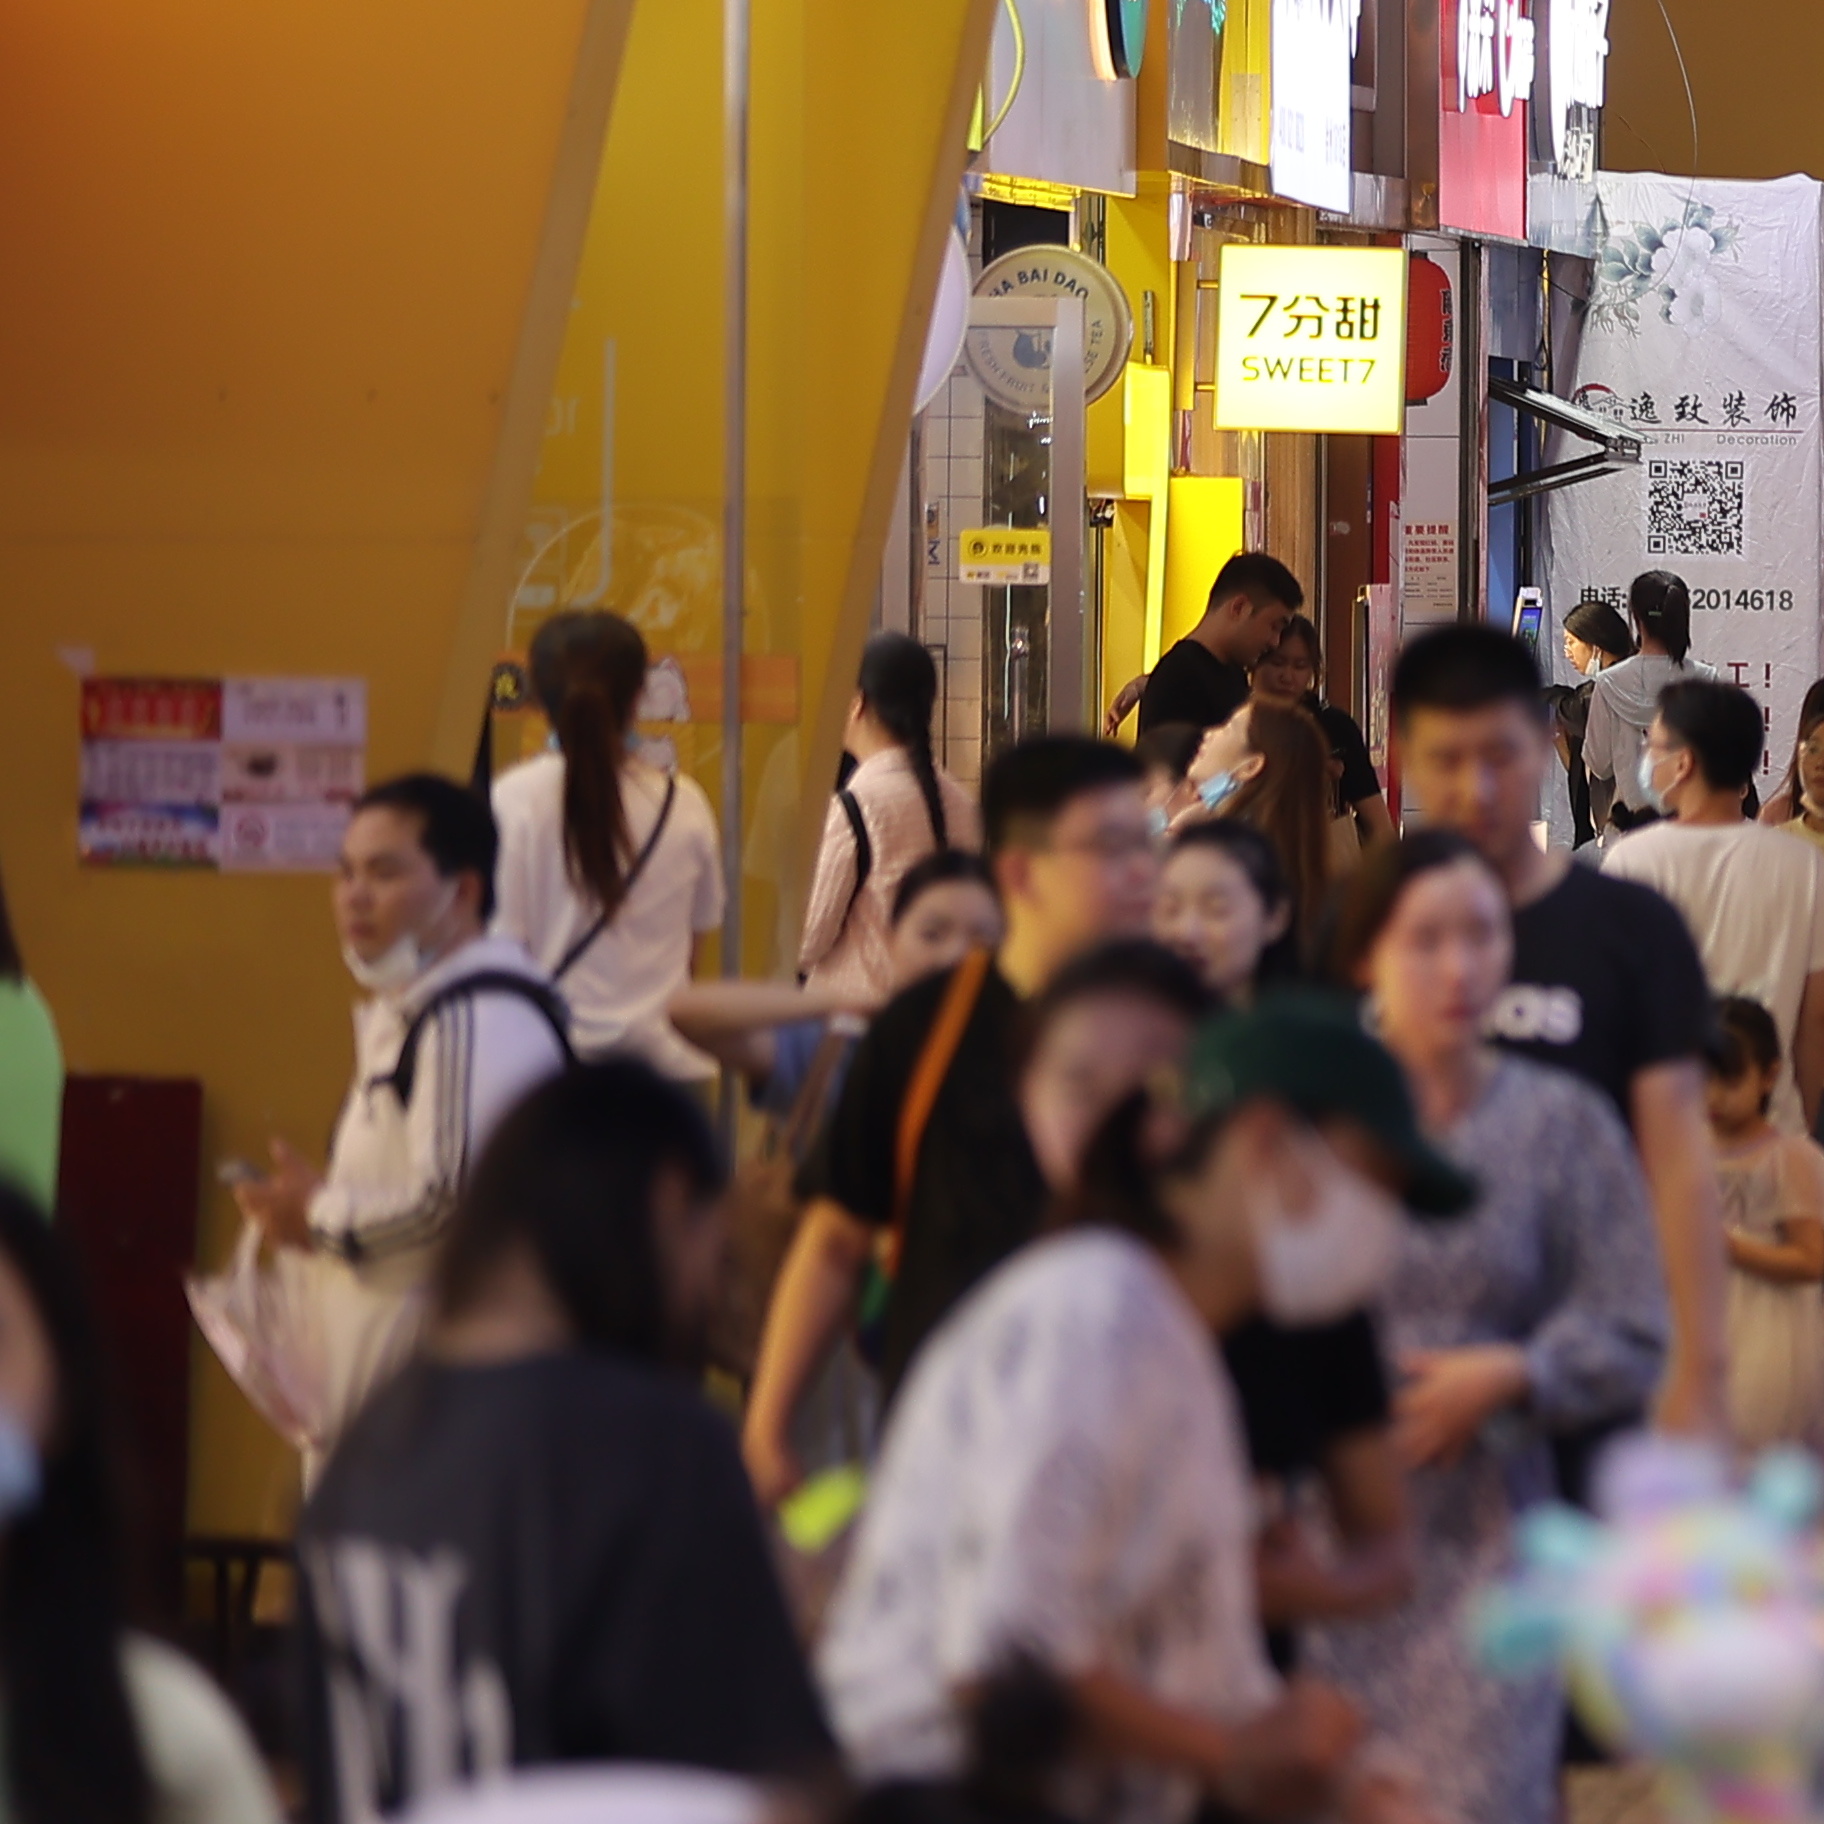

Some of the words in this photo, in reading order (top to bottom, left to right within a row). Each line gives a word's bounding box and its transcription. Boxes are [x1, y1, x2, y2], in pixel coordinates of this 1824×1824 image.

[1017, 268, 1049, 285] BAI
[1240, 294, 1381, 341] 7分甜
[1241, 356, 1377, 384] SWEET7
[1629, 390, 1797, 428] 逸致装饰
[1716, 433, 1798, 446] Decoration
[1686, 588, 1793, 612] 2014618
